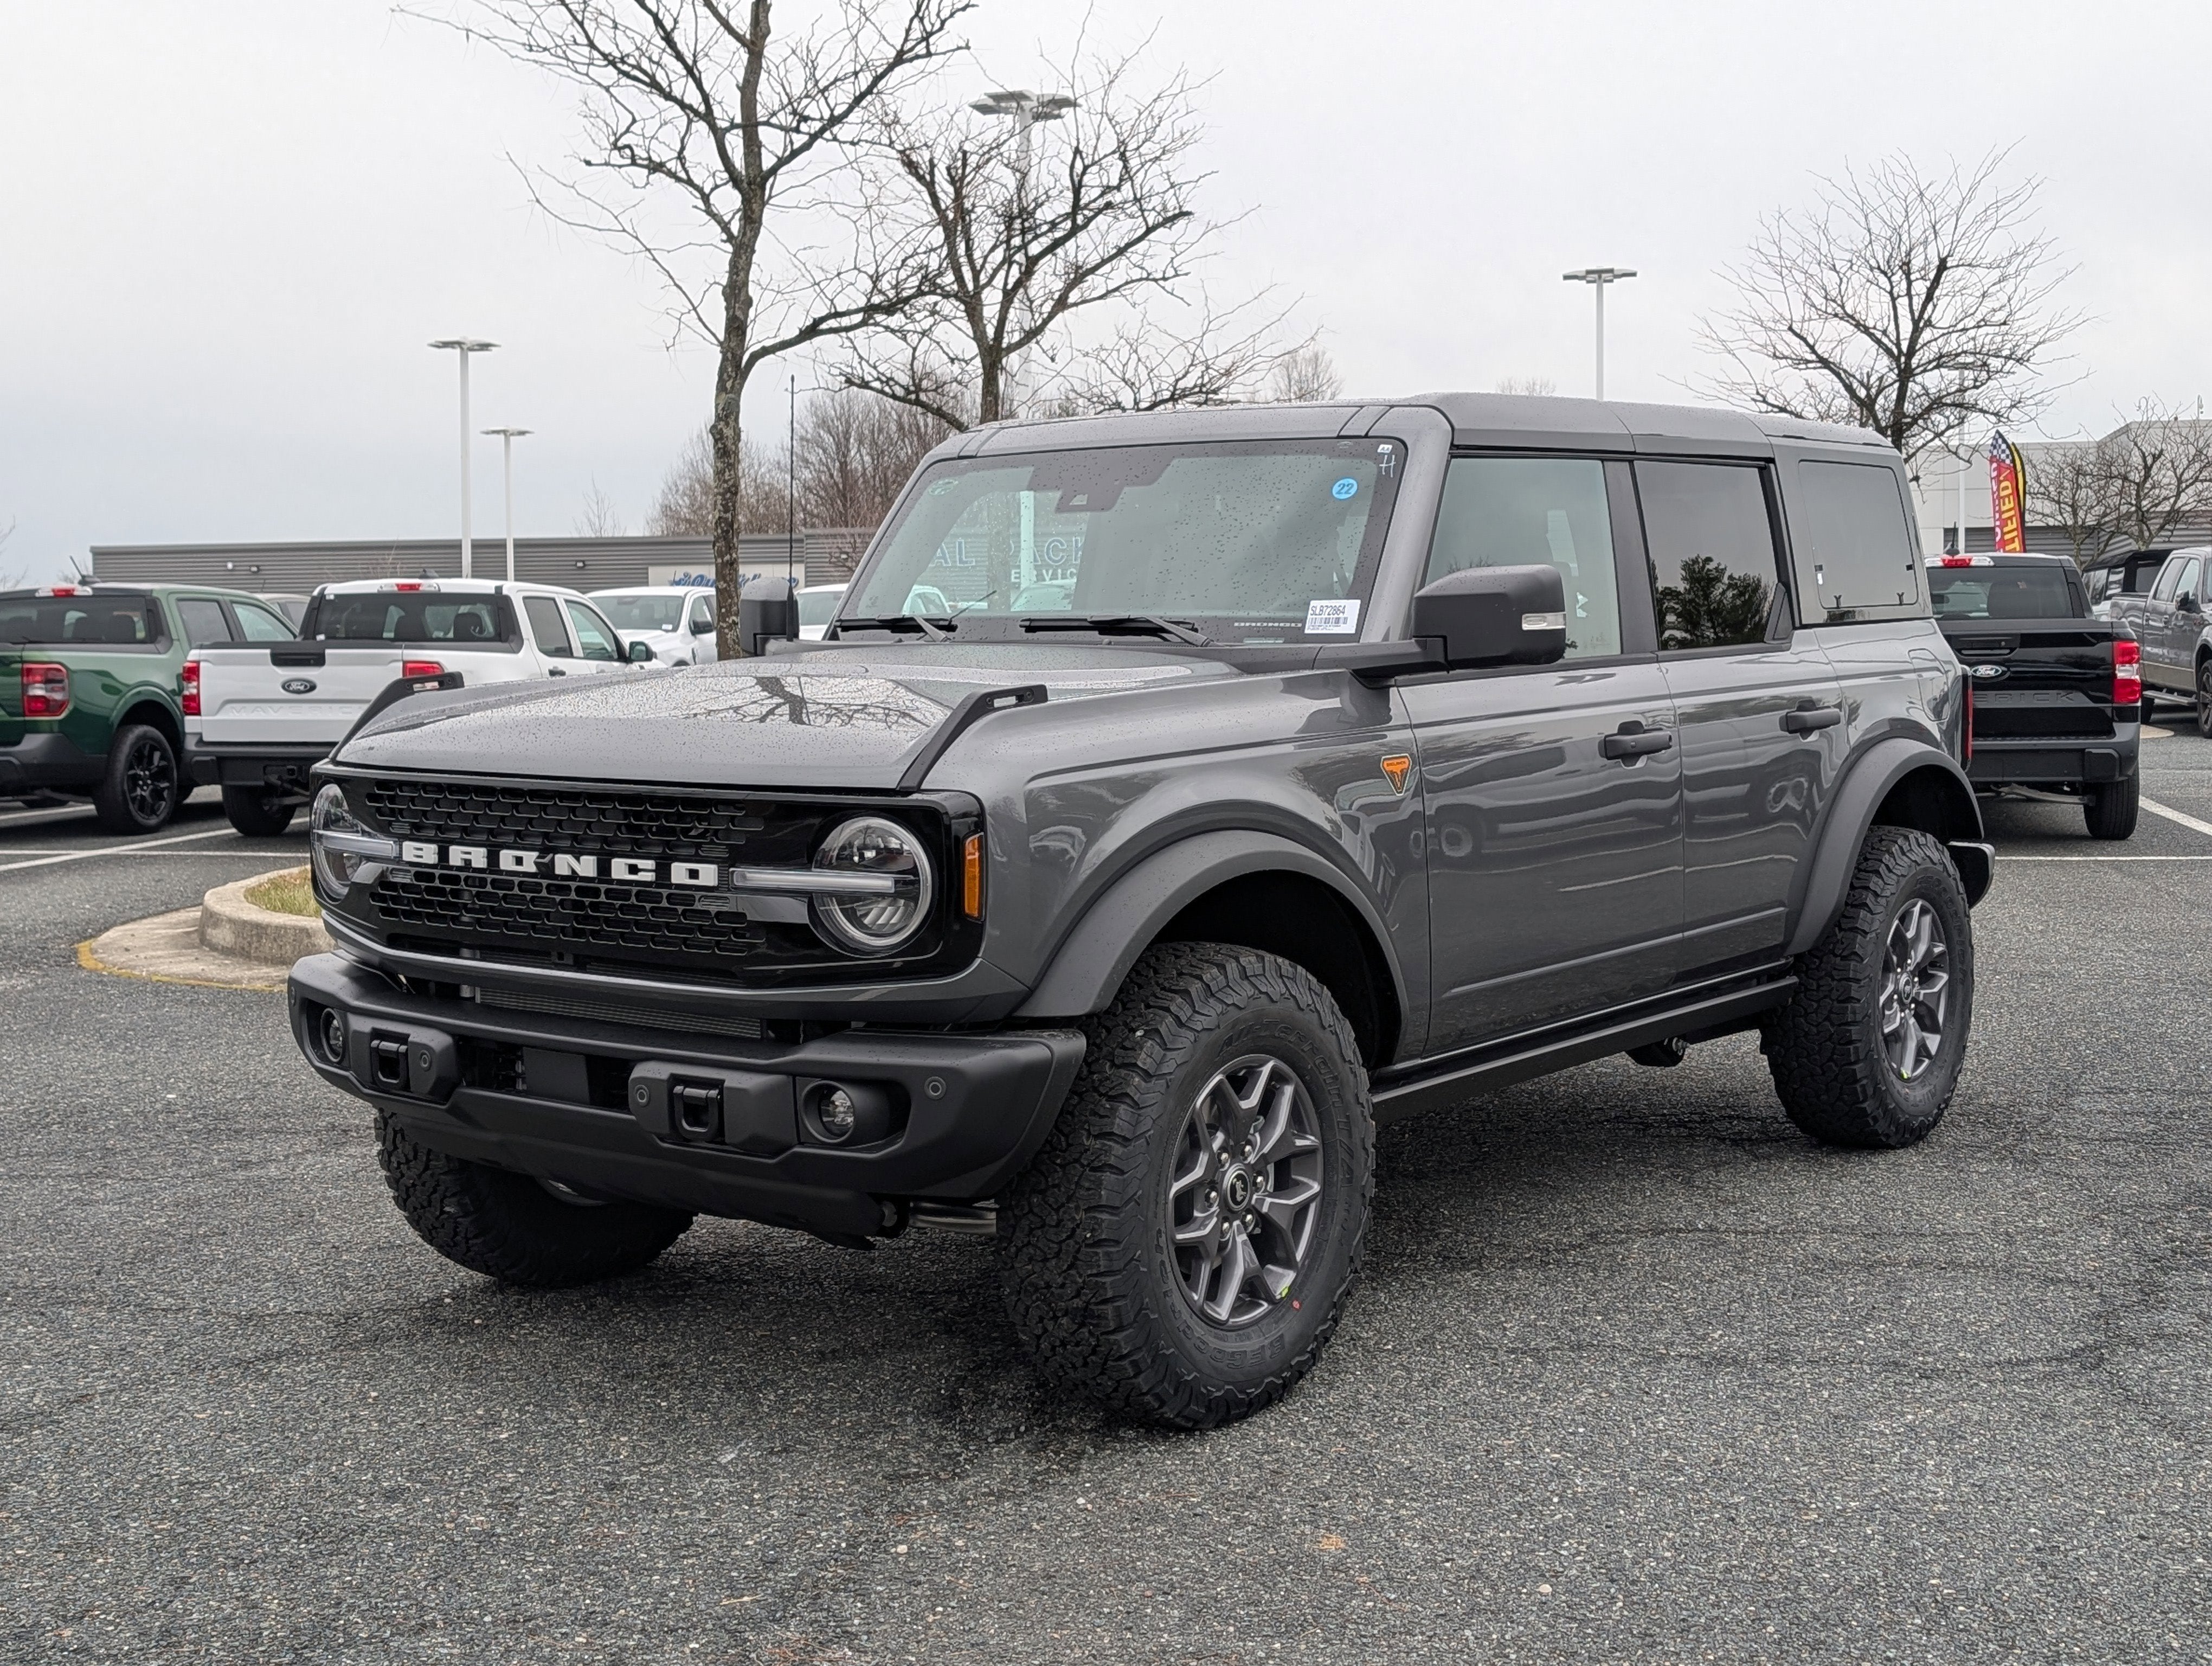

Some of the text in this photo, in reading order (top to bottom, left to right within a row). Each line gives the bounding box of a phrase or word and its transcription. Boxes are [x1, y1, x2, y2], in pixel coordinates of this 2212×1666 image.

[1335, 483, 1354, 495] 22
[1310, 605, 1346, 616] SLB72864
[402, 841, 719, 887] BRONCO
